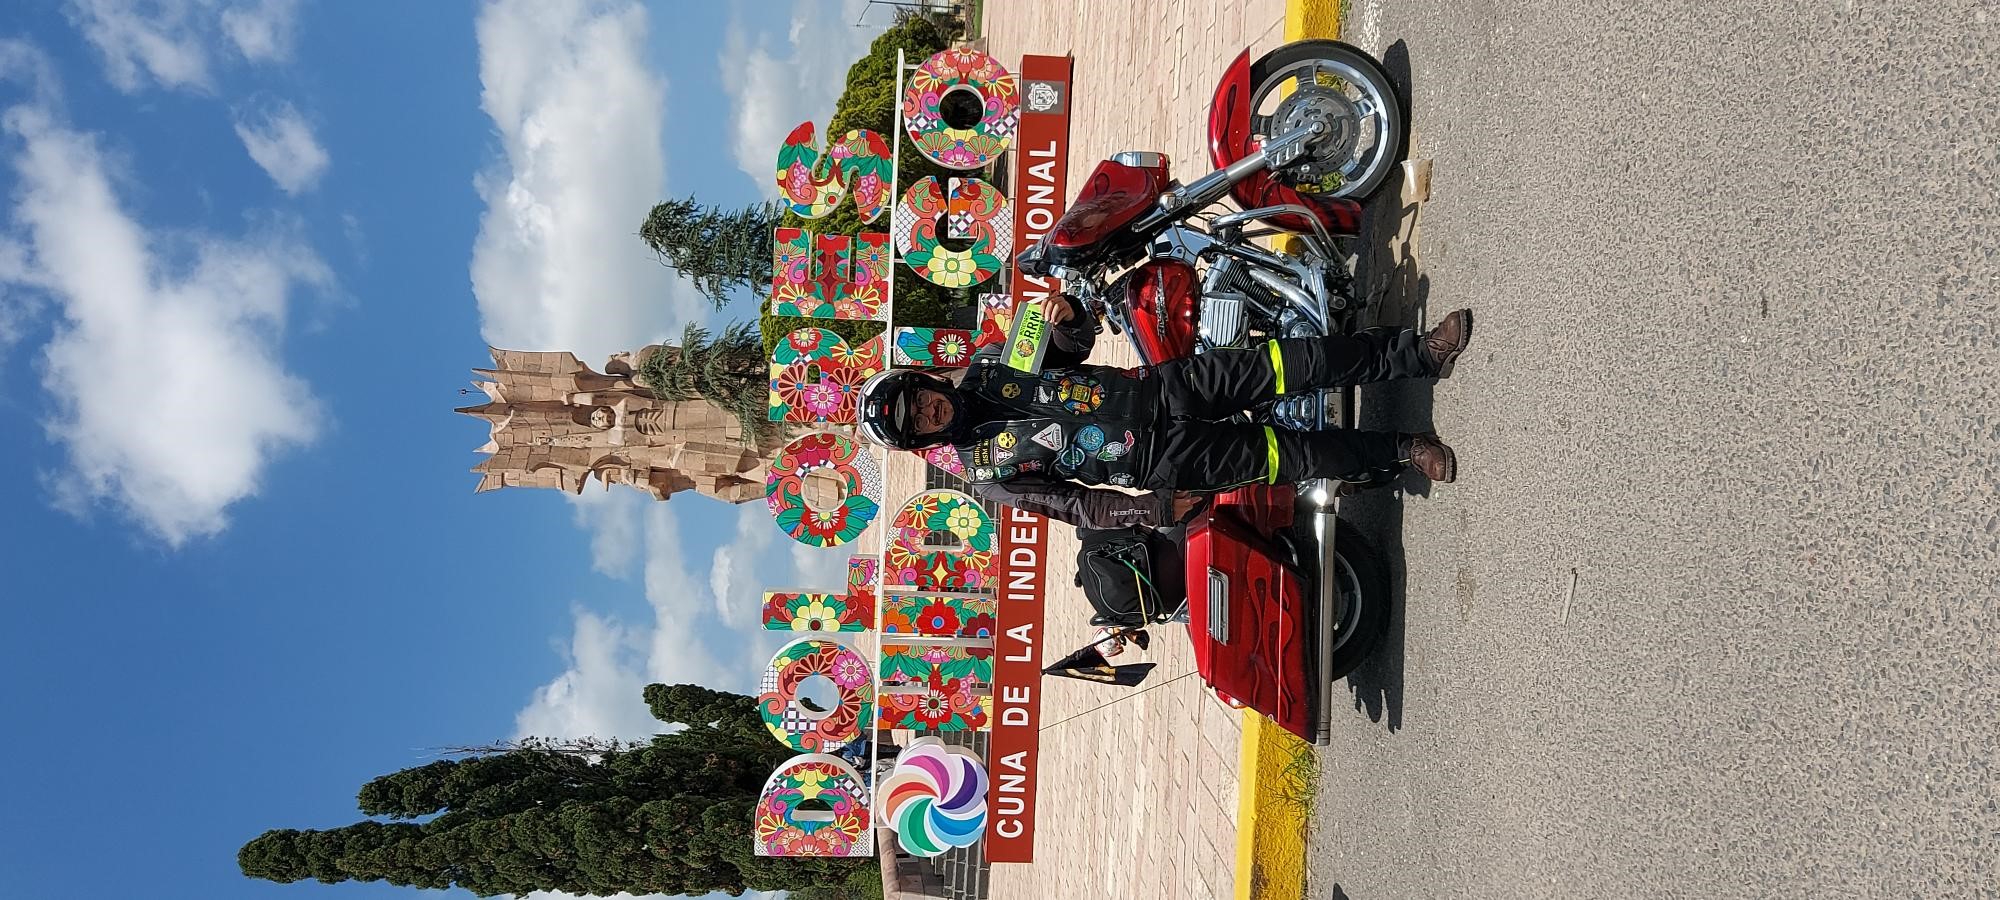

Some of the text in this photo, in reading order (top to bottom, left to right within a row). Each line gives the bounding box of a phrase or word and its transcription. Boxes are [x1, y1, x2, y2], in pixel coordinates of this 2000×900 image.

[1022, 140, 1057, 304] NAIONAL
[1024, 310, 1041, 339] RRM
[754, 121, 892, 856] DOLORES
[1005, 623, 1033, 662] LA
[1002, 685, 1030, 726] DE
[996, 750, 1027, 839] CUNA
